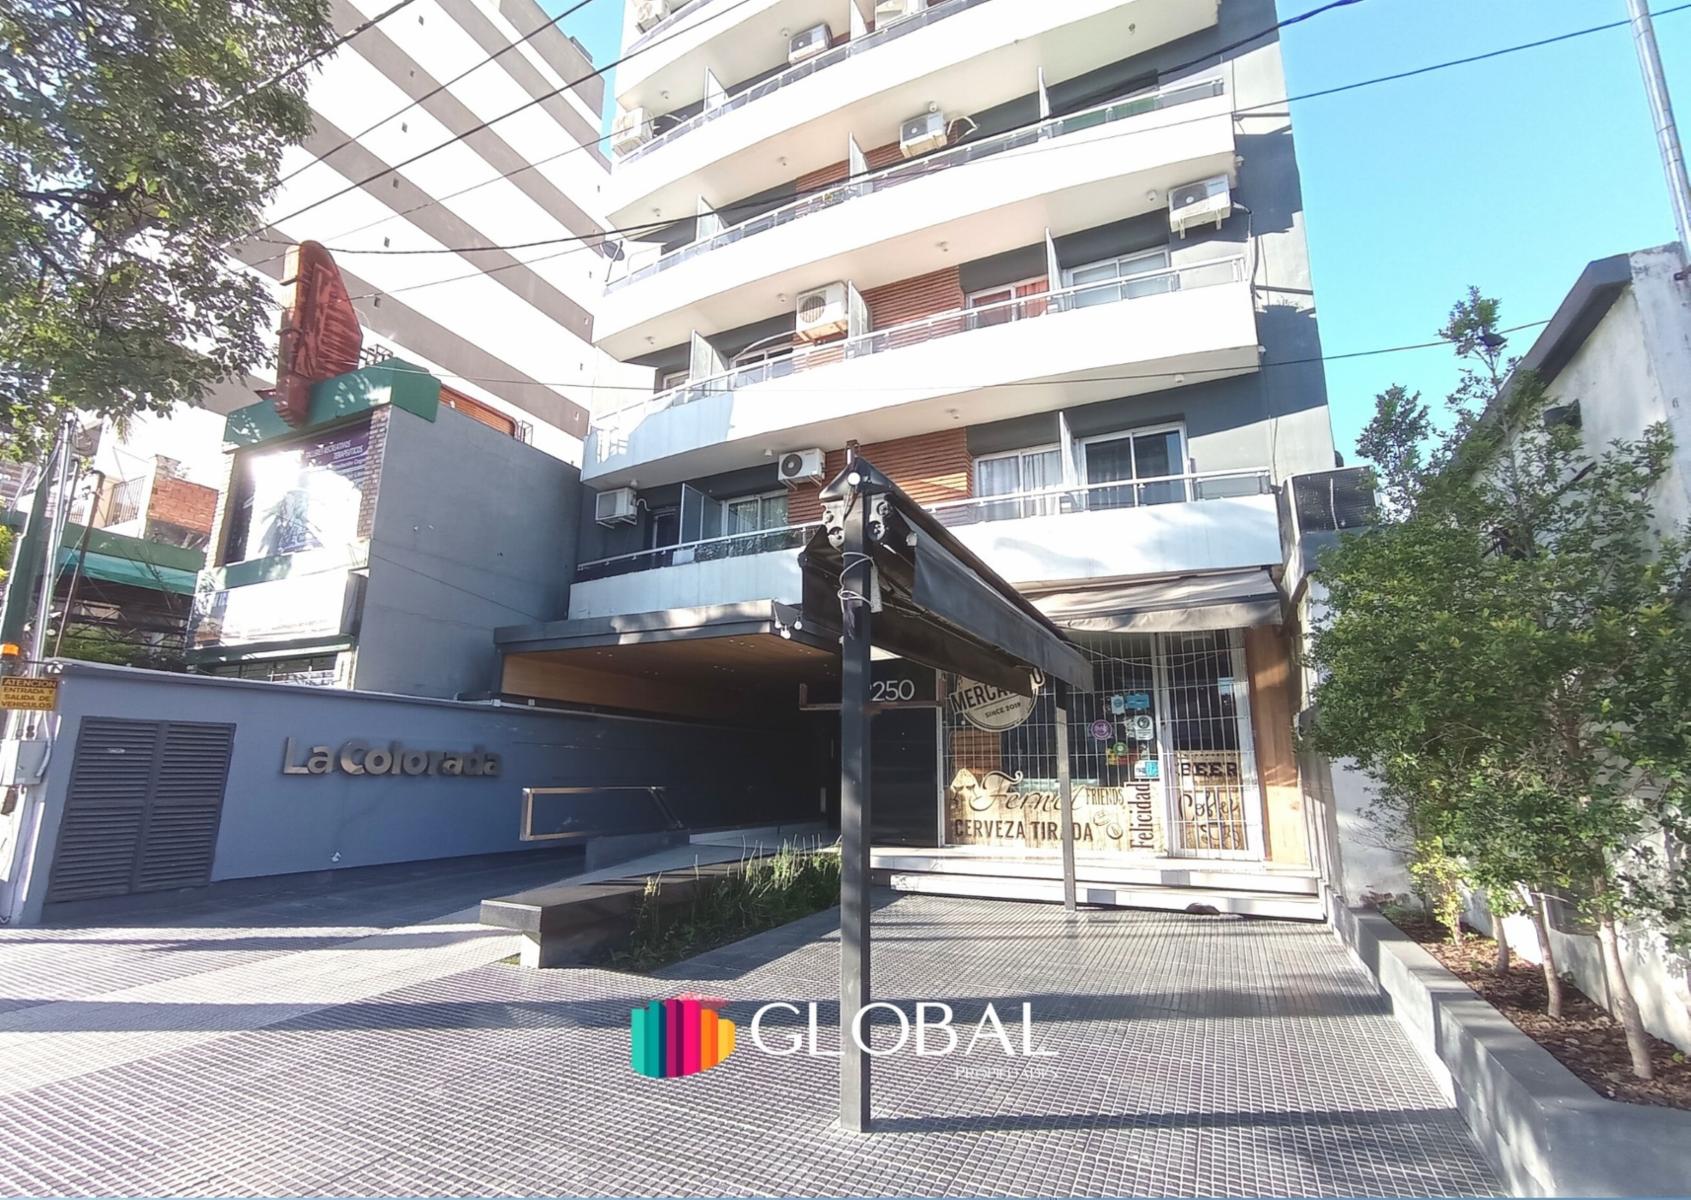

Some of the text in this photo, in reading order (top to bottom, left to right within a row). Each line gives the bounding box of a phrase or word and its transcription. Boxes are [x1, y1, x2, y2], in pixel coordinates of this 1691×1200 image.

[869, 679, 915, 702] 250
[282, 736, 501, 777] La Colorada
[1180, 762, 1237, 777] BEER
[1085, 787, 1125, 806] FRIENDS
[1126, 783, 1155, 849] Felicidad
[955, 819, 1094, 842] CERVEZA TIRDA
